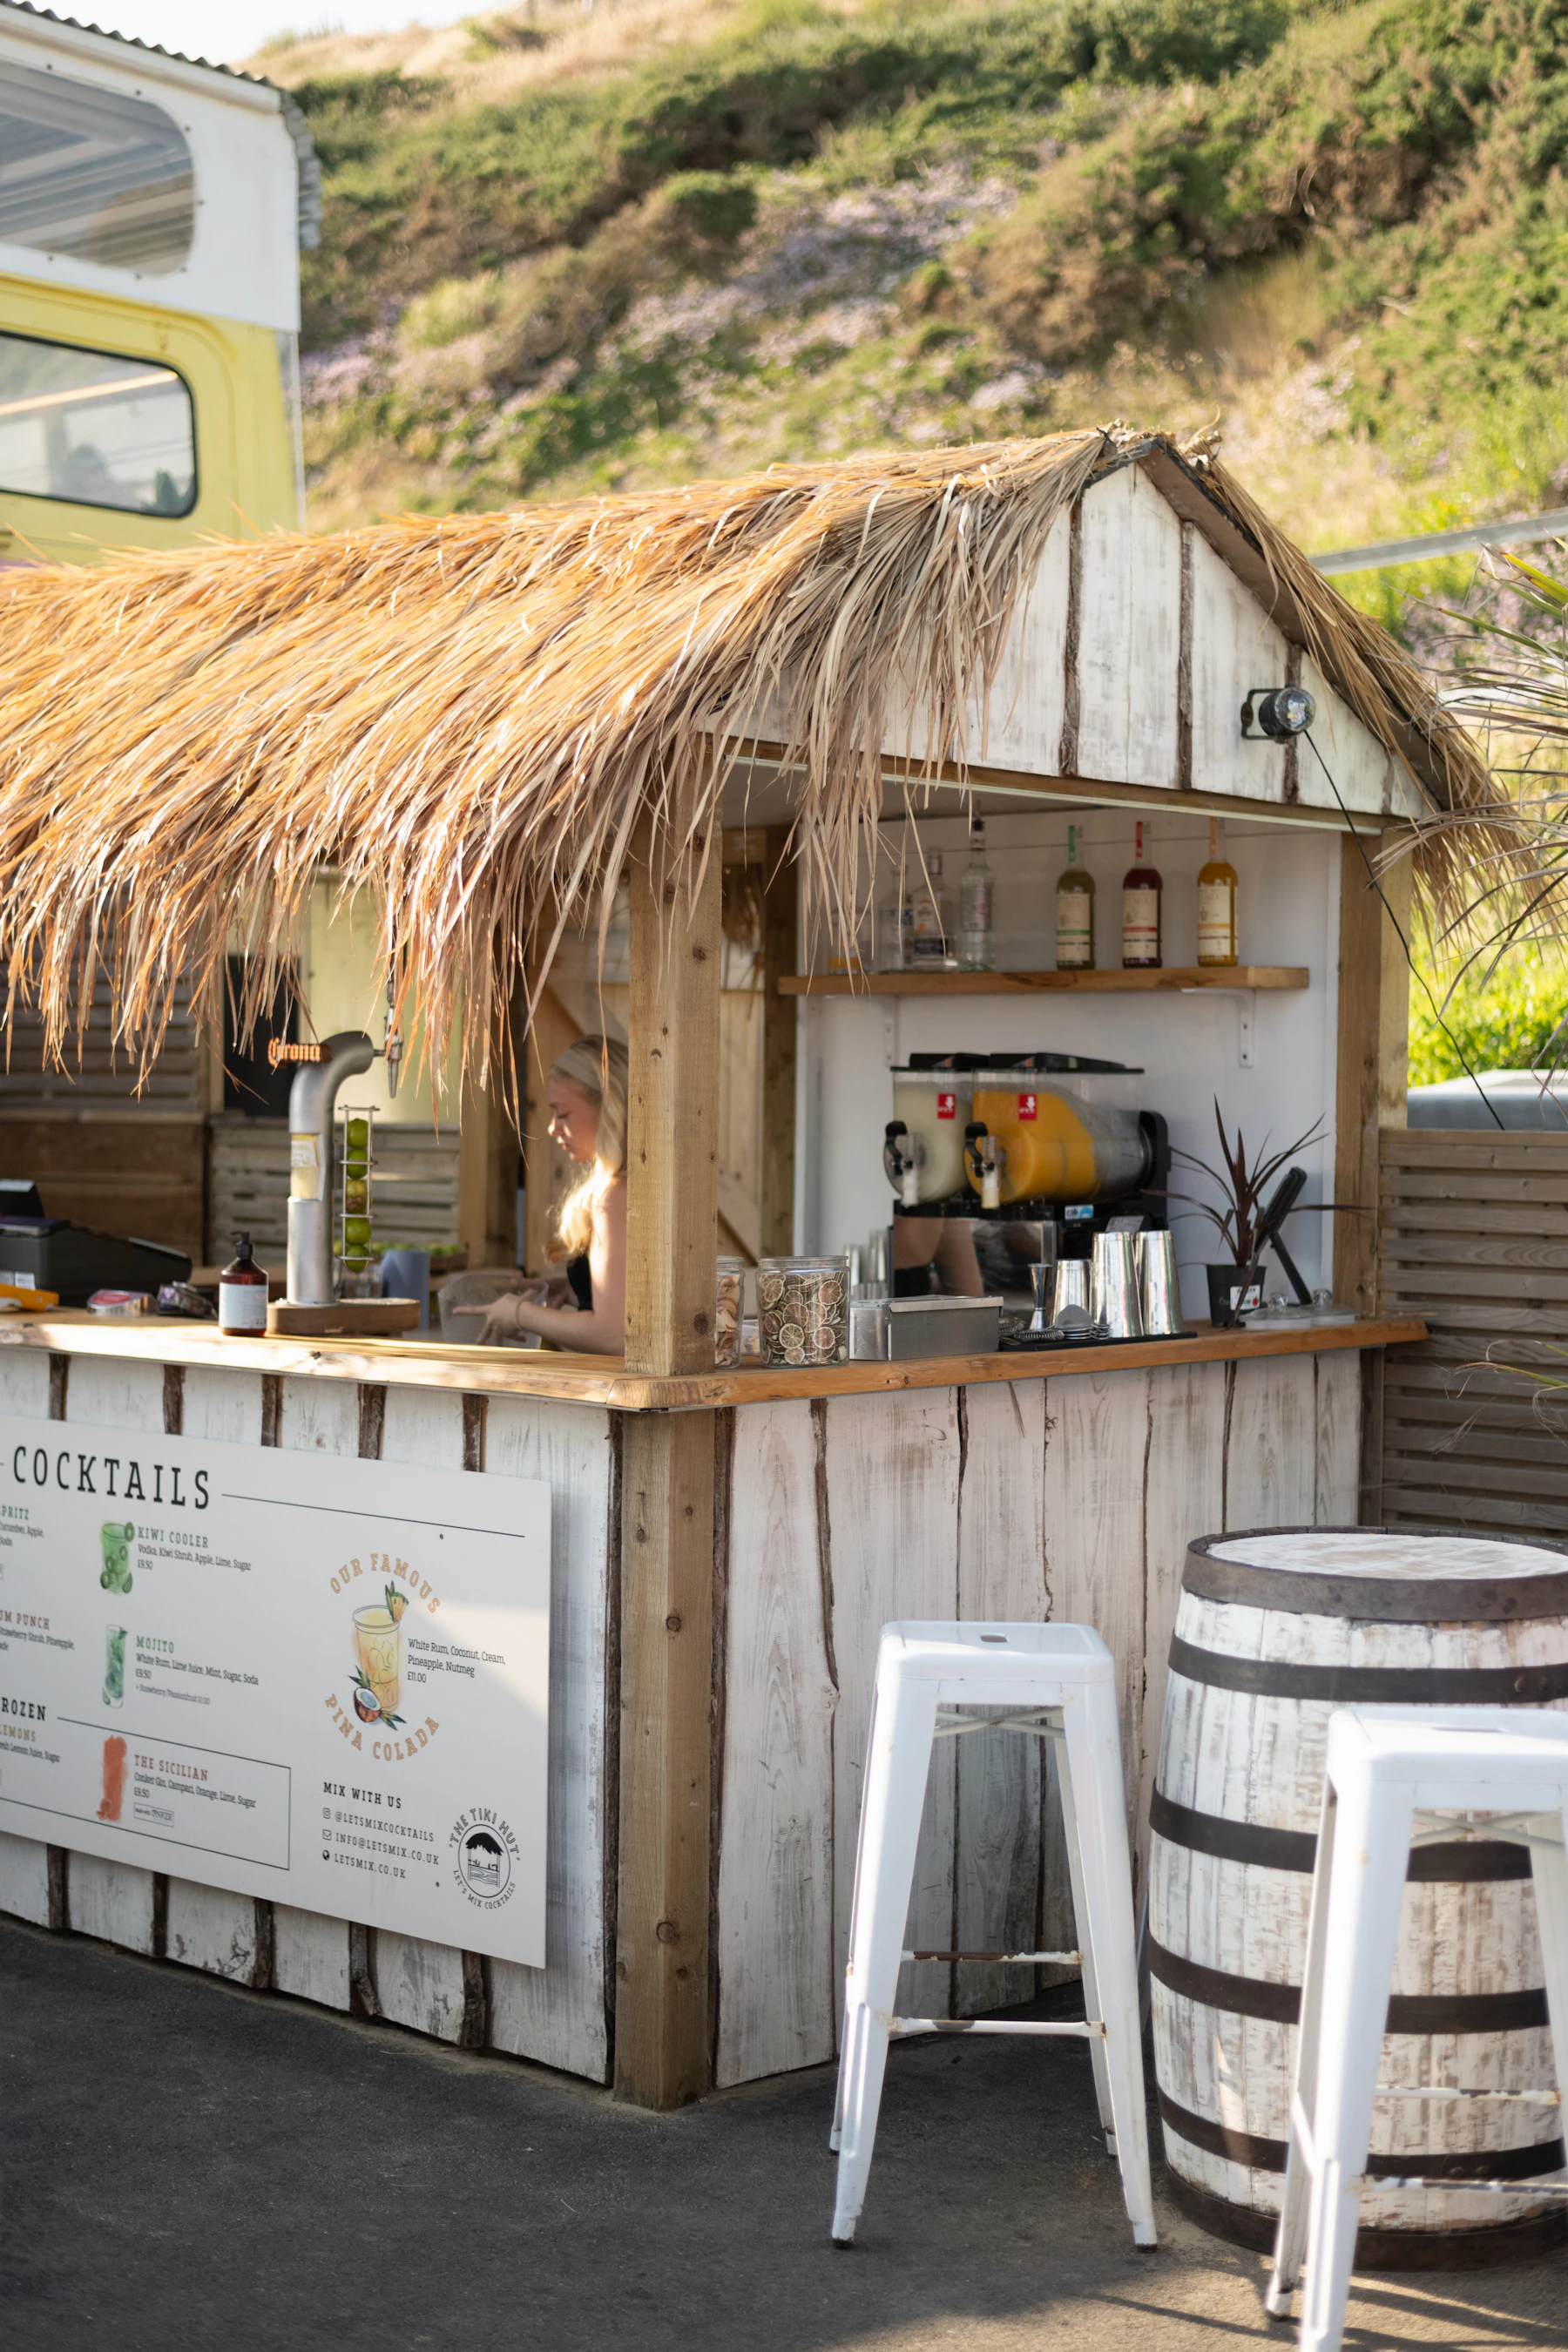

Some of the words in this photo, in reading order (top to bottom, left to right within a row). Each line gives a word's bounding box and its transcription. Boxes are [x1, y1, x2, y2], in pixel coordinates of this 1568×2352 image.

[14, 1446, 209, 1510] COCKTAILS
[0, 1504, 29, 1521] PRITZ
[138, 1526, 165, 1542] KIWI
[169, 1531, 209, 1548] COOLER
[137, 1559, 153, 1570] £9.50
[138, 1544, 158, 1557] Vodka,
[159, 1547, 173, 1558] Kiwi
[195, 1553, 214, 1566] Apple,
[215, 1556, 233, 1568] Lime,
[233, 1559, 252, 1572] Sugar
[330, 1558, 363, 1594] OUR
[370, 1553, 440, 1612] FAMOUS
[17, 1612, 51, 1630] PUNCH
[136, 1635, 174, 1654] MOJITO
[408, 1639, 429, 1651] White
[430, 1642, 449, 1655] Rum,
[450, 1646, 480, 1660] Coconut,
[481, 1651, 506, 1665] Cream,
[136, 1652, 154, 1665] White
[155, 1656, 171, 1668] Rum,
[172, 1659, 187, 1672] Lime
[188, 1662, 205, 1675] Juice,
[206, 1666, 222, 1679] Mint,
[223, 1670, 242, 1683] Sugar,
[243, 1673, 259, 1686] Soda
[407, 1671, 427, 1683] £11.00
[408, 1654, 444, 1671] Pineapple,
[445, 1661, 475, 1679] Nutmeg
[325, 1693, 362, 1751] PINA
[373, 1717, 440, 1761] COLADA
[134, 1754, 154, 1770] THE
[159, 1760, 208, 1781] SICILIAN
[155, 1777, 166, 1788] Gin,
[168, 1779, 195, 1794] Campari,
[220, 1791, 237, 1804] Lime,
[238, 1795, 256, 1809] Sugar
[323, 1781, 346, 1797] MIX
[351, 1788, 382, 1805] WITH
[388, 1795, 402, 1809] US
[335, 1811, 434, 1842] @LETSMIXCOCKTAILS
[470, 1808, 497, 1824] TIKI
[335, 1832, 439, 1865] INFO@LETSMIX.CO.UK
[335, 1853, 406, 1879] LETSMIX.CO.UK
[453, 1869, 468, 1895] LET'S
[468, 1894, 483, 1908] MIX
[484, 1882, 516, 1909] COCKTAILS
